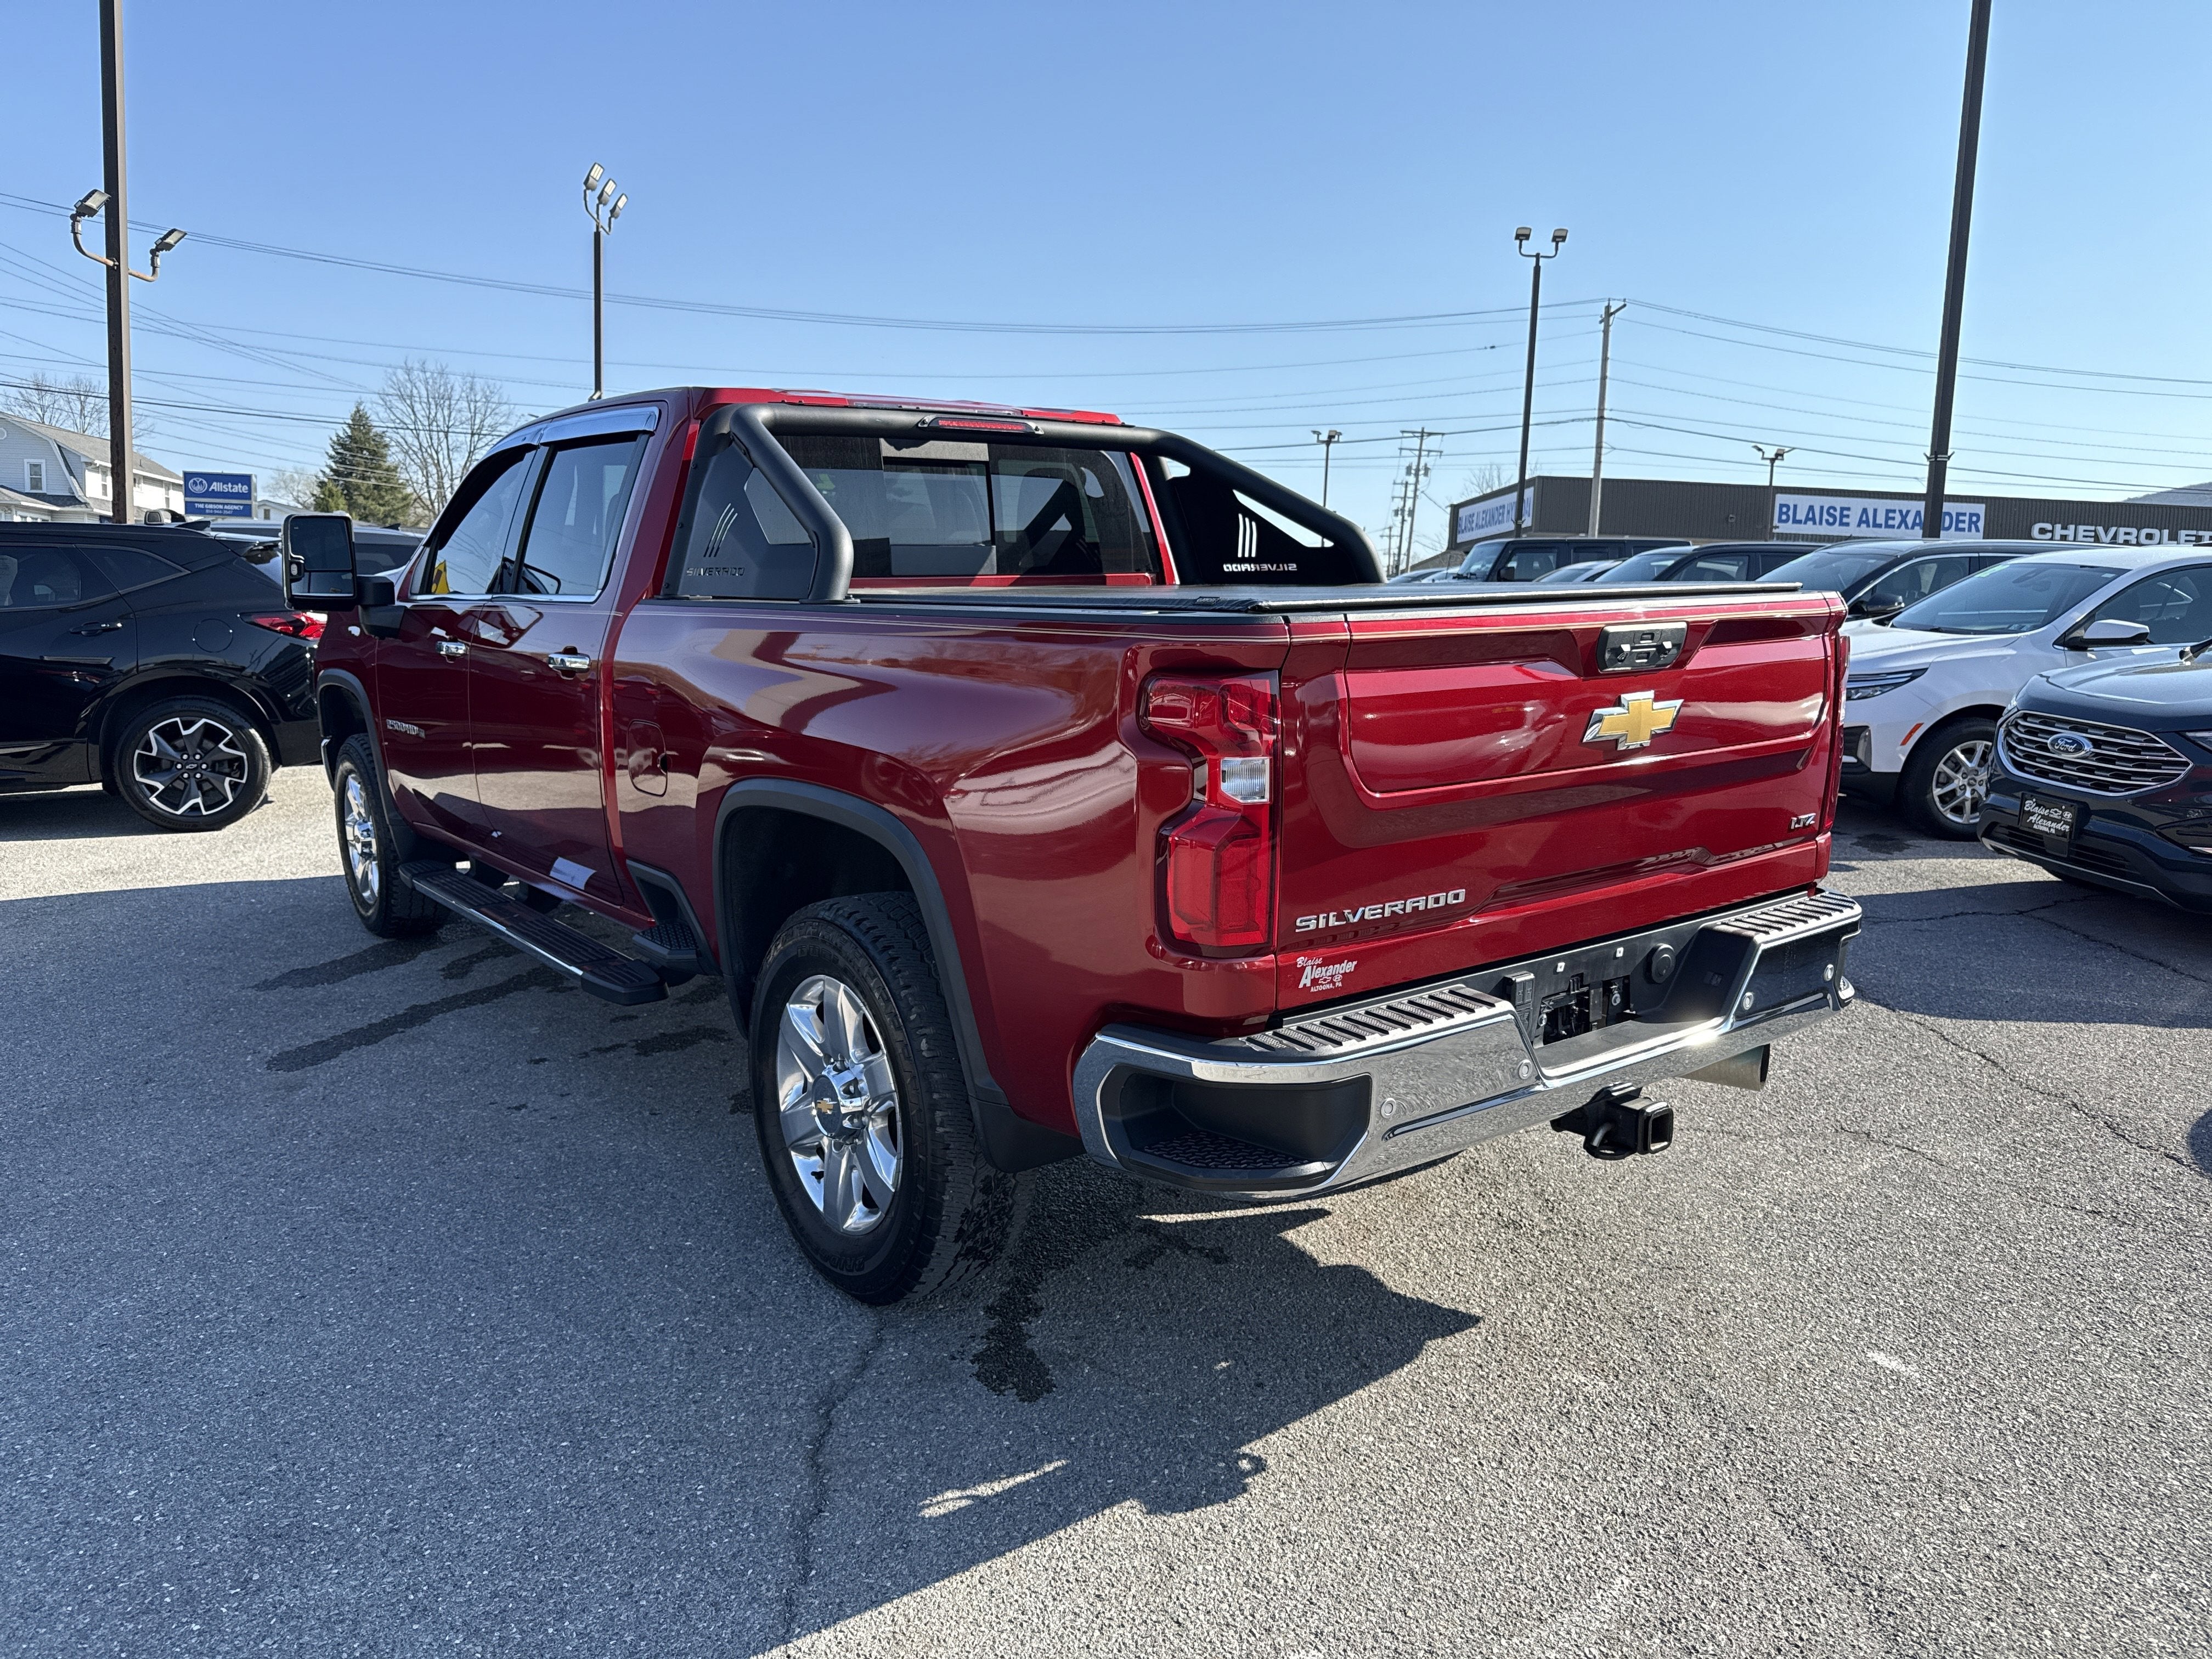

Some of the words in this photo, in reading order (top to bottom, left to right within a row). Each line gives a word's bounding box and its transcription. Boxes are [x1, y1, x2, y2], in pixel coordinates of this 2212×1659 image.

[209, 482, 249, 493] Allstate
[1458, 513, 1475, 534] BLAISE
[1475, 505, 1505, 530] ALEXANDER
[1778, 503, 1851, 527] BLAISE
[1857, 507, 1981, 533] ALEXADER
[2031, 522, 2212, 545] CHEVROLET
[687, 567, 745, 576] SILVERADO
[2054, 737, 2077, 752] Ford
[2024, 800, 2050, 816] Blaise
[2027, 813, 2070, 832] Alexander
[1295, 889, 1465, 932] SILVERADO
[1296, 956, 1323, 968] Blaise
[1298, 960, 1358, 989] Alexander
[1310, 984, 1334, 992] ALTOONA,
